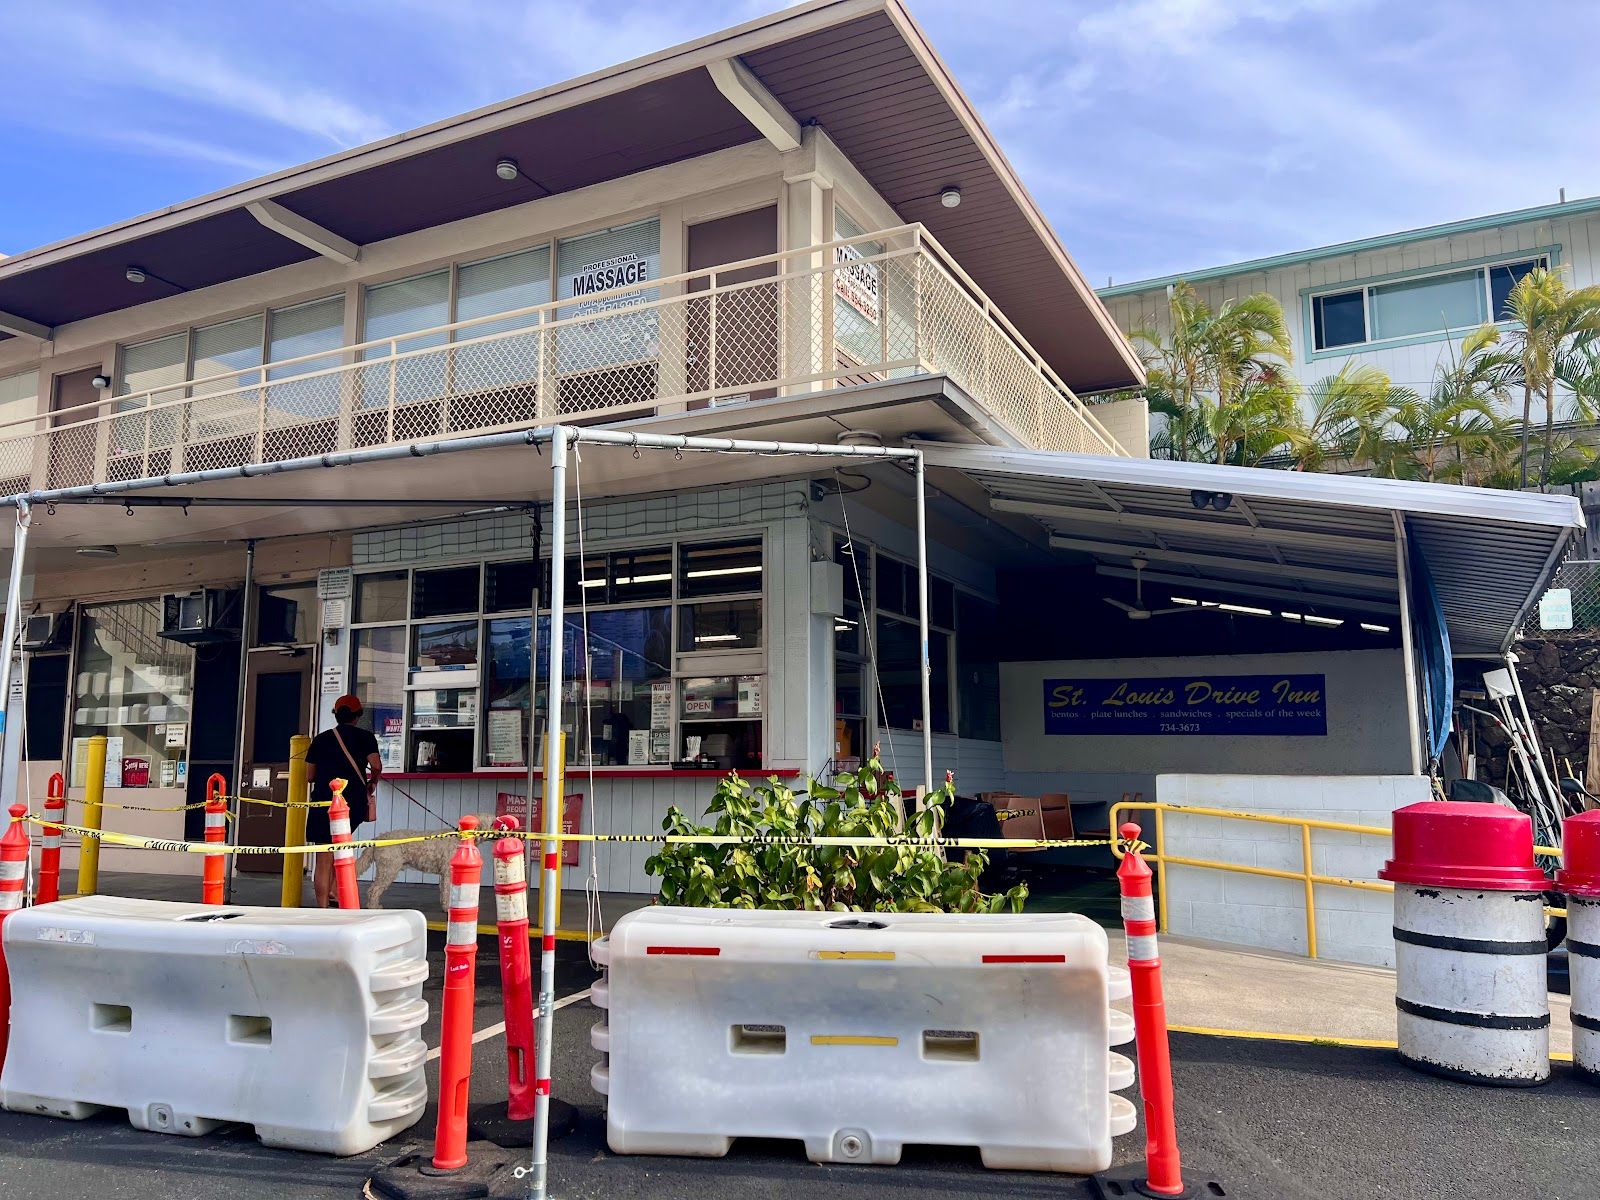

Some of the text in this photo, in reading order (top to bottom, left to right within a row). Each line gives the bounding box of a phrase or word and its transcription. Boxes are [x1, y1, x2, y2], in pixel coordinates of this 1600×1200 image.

[583, 254, 637, 272] PROFESSIONAL
[573, 261, 647, 297] MASSAGE
[1048, 679, 1321, 708] St. Louis Drive Inn
[686, 702, 711, 711] OPEN
[1051, 708, 1321, 720] bentos plate lunches sandwiches specials of the week
[418, 716, 438, 725] OPEN
[1159, 723, 1200, 732] 734-3673
[124, 760, 138, 772] Sorry
[506, 795, 538, 806] MASS
[740, 836, 813, 844] CAUTION
[886, 837, 960, 846] CAUTION
[144, 840, 191, 852] CAUTION
